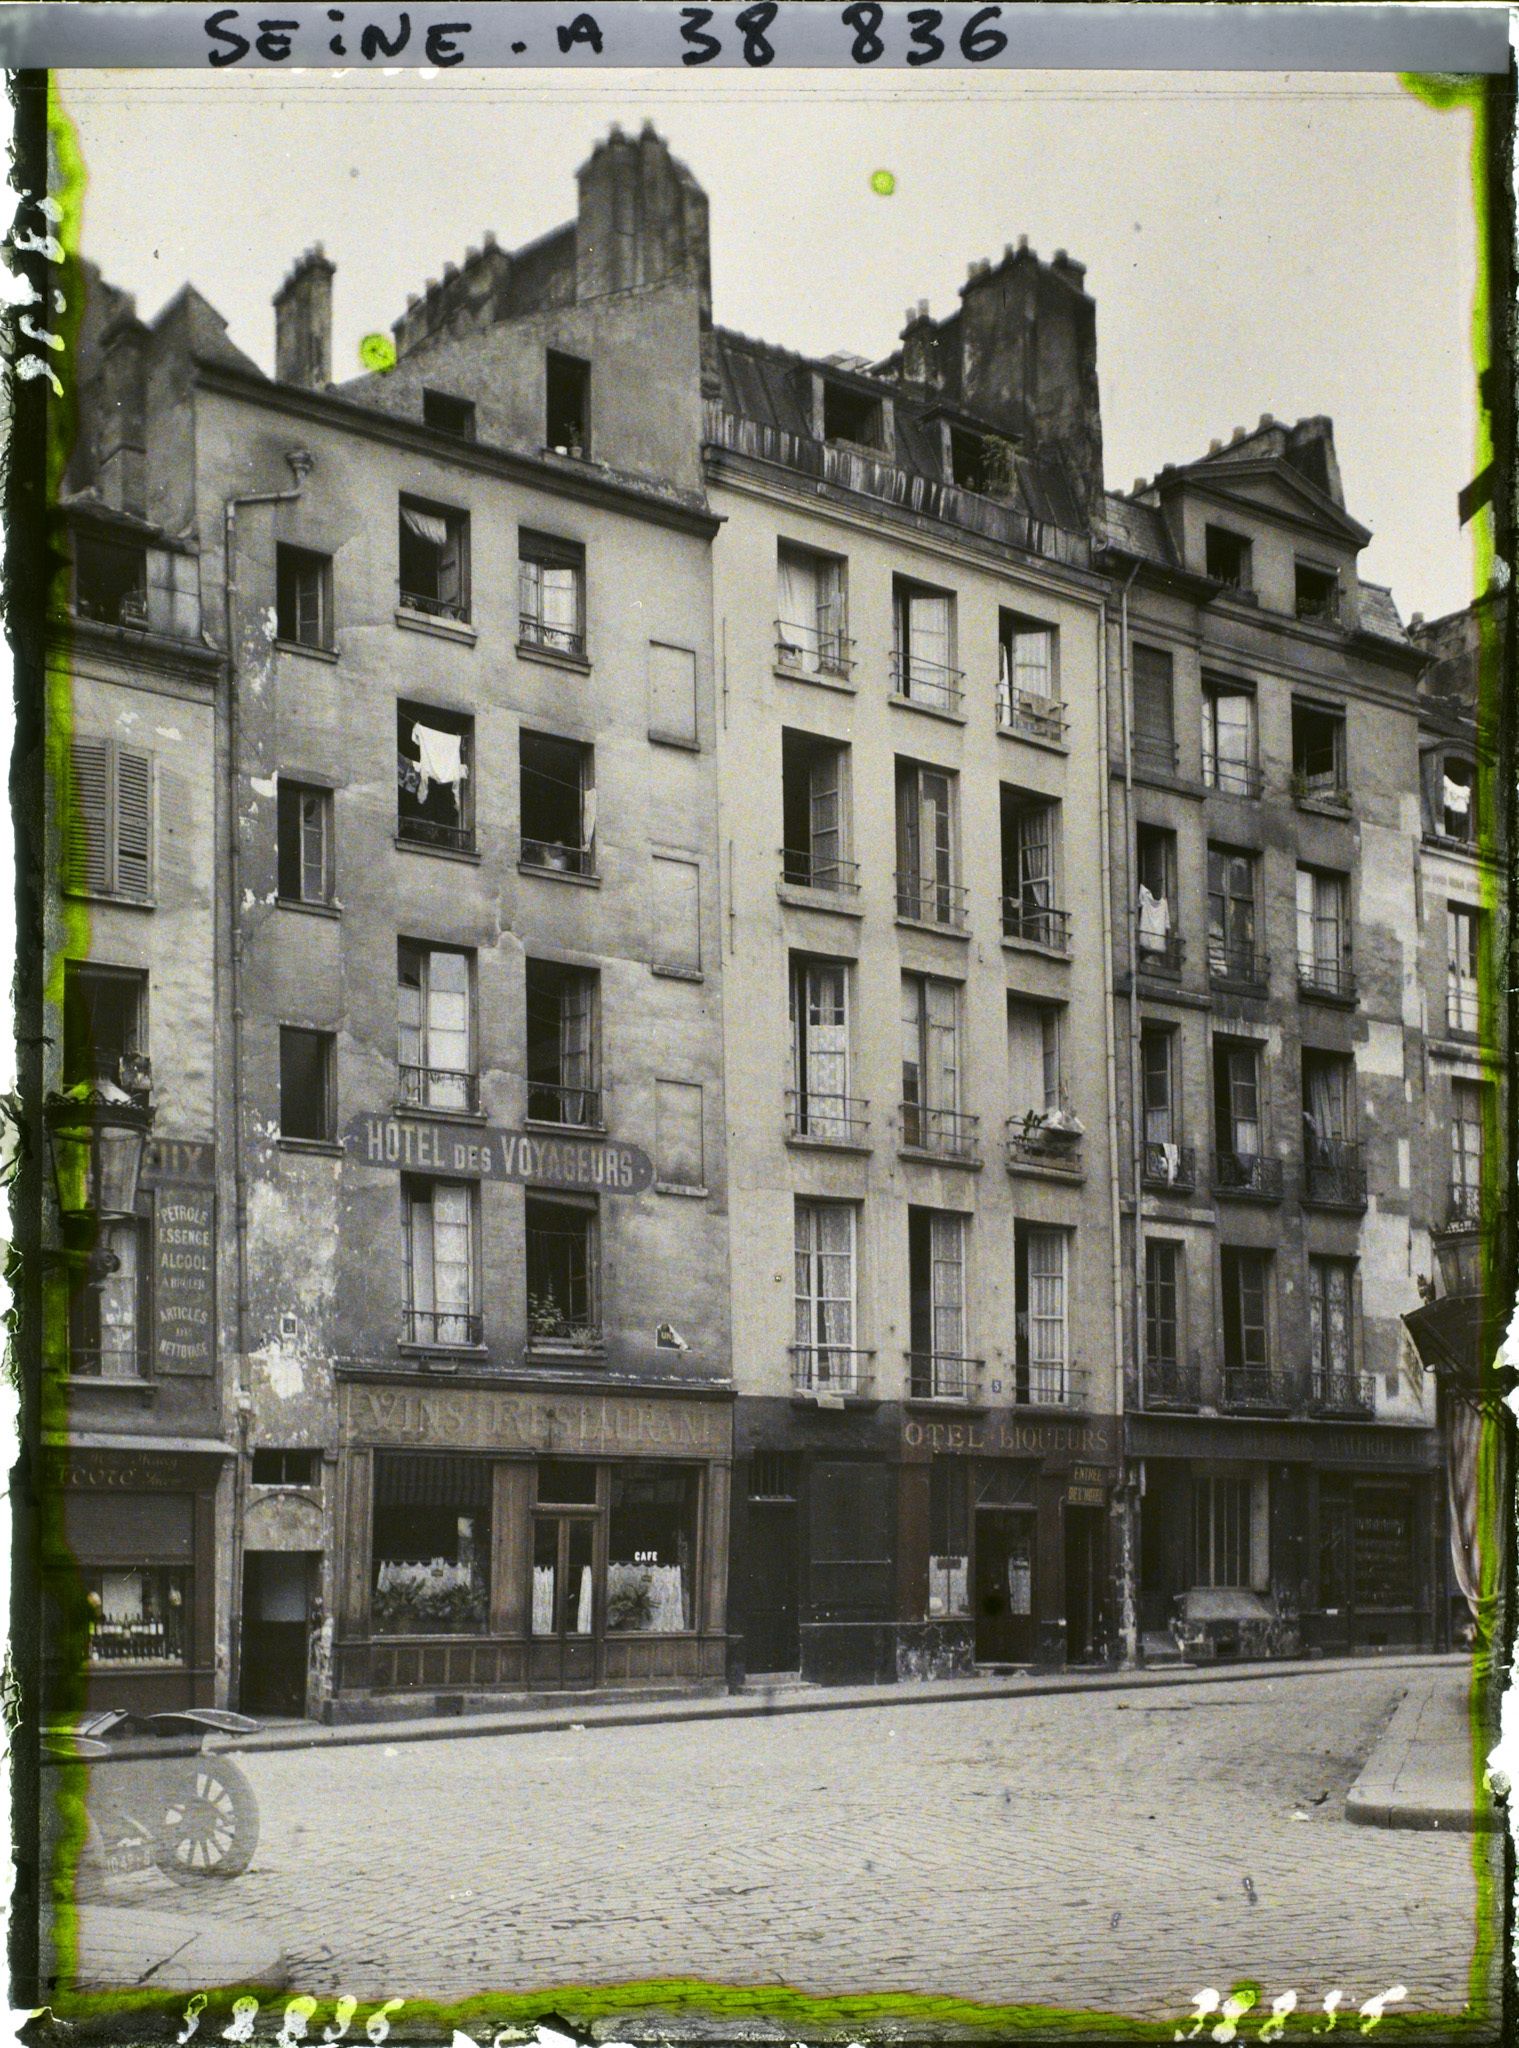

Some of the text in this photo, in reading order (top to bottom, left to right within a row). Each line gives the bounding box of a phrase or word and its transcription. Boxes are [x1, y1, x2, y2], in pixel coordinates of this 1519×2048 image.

[557, 14, 605, 55] A
[680, 5, 779, 67] 38
[850, 4, 1009, 67] 836
[366, 1115, 634, 1188] HÔTEL DES VOYAGEURS
[160, 1228, 209, 1246] ESSENCE
[161, 1253, 209, 1271] ALCOOL
[160, 1307, 208, 1325] ARTICLES
[999, 1423, 1109, 1452] LIQUEURS
